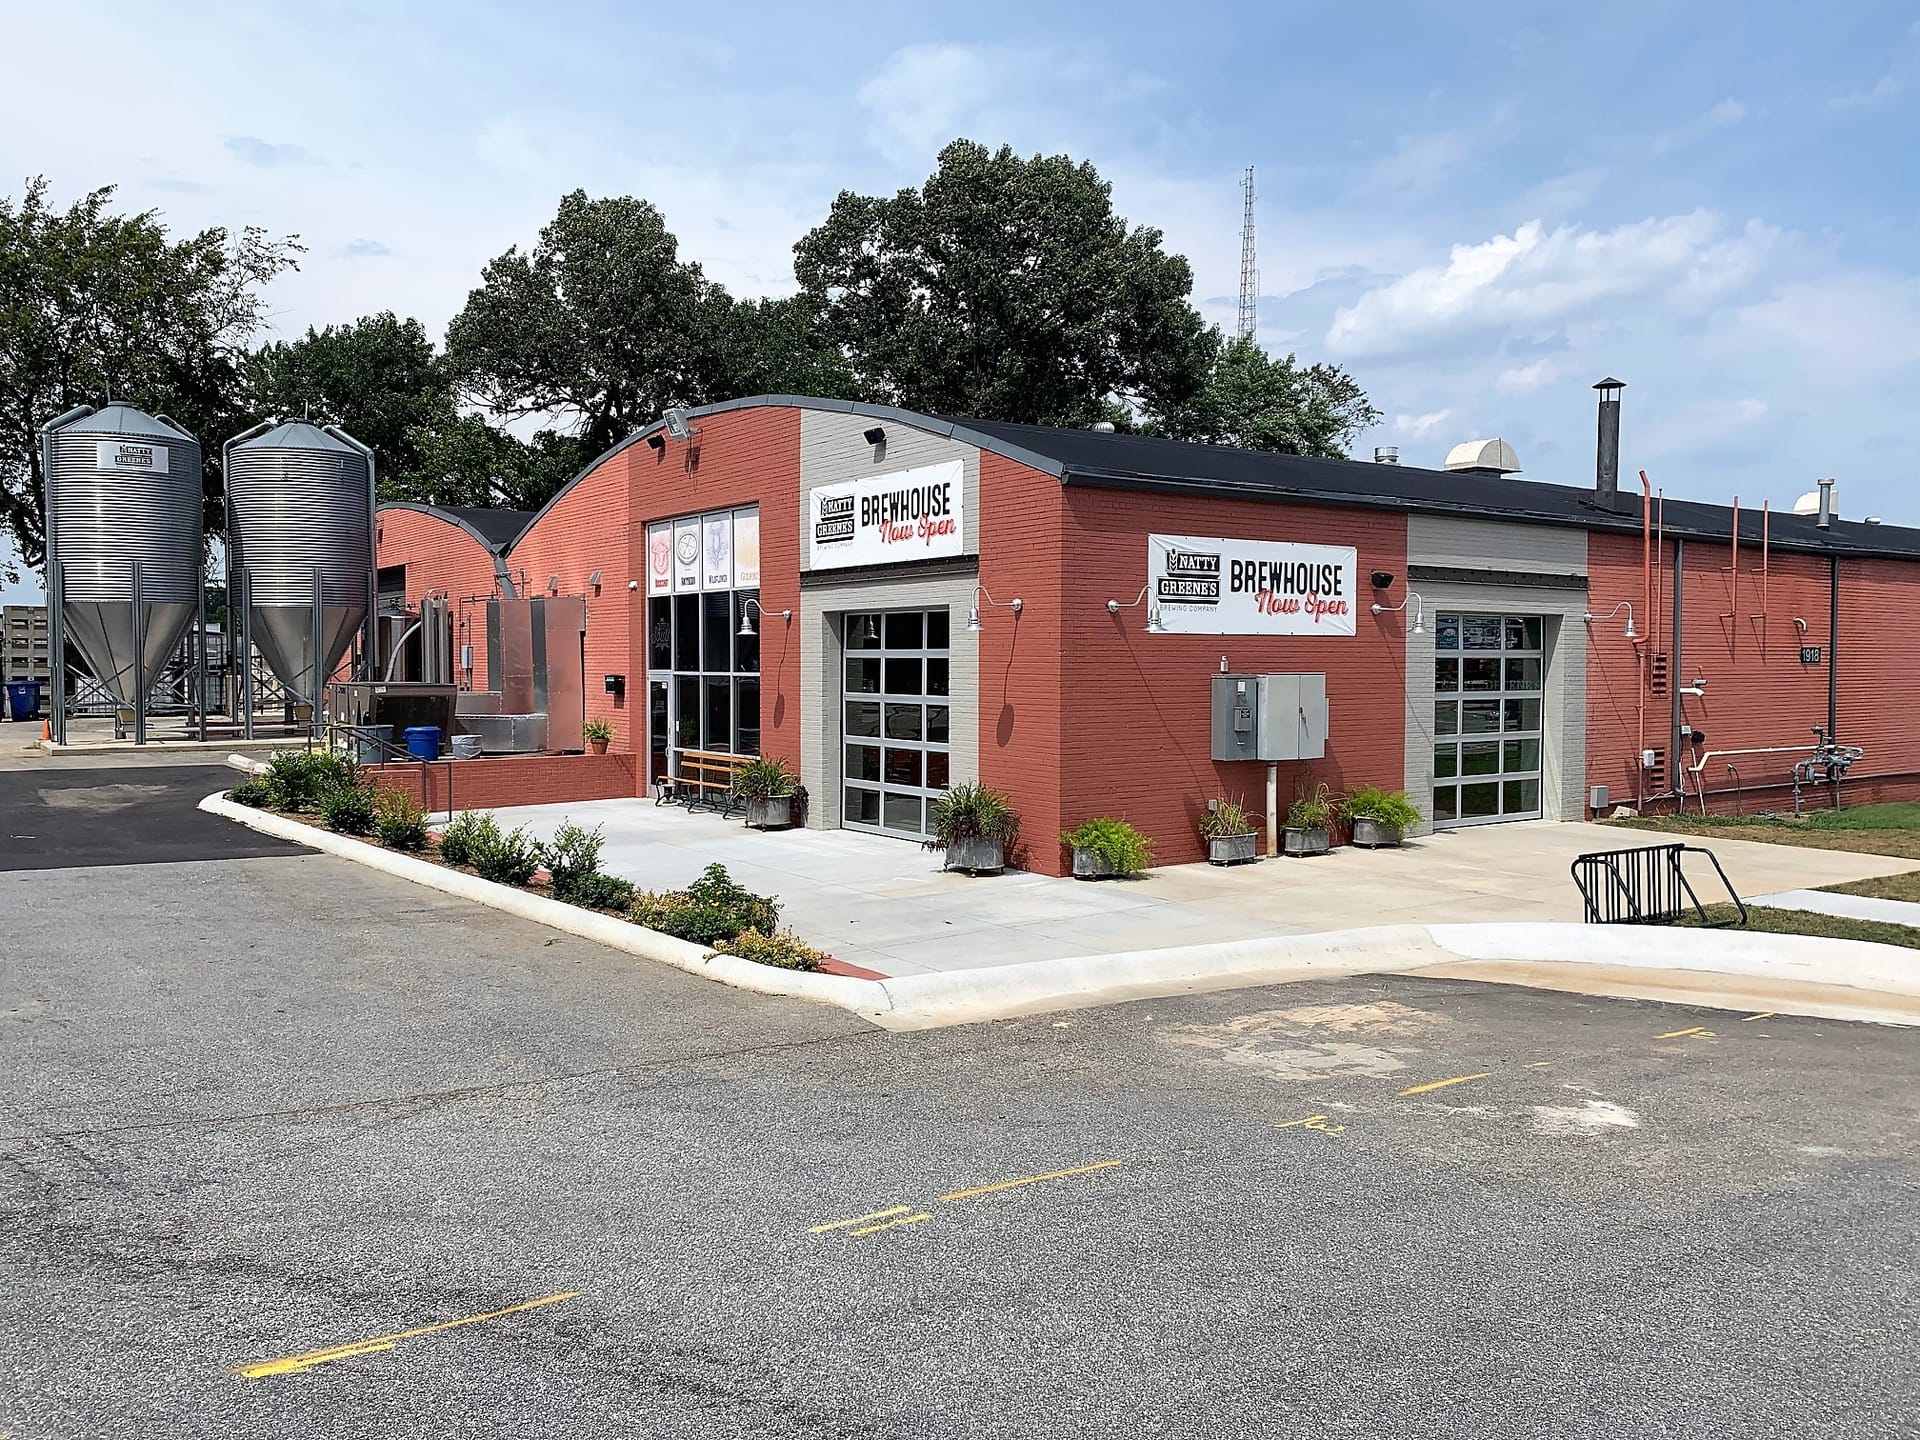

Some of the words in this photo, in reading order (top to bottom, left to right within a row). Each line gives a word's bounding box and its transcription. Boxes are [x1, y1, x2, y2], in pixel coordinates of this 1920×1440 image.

[828, 497, 853, 512] NATTY
[862, 482, 950, 527] BREWHOUSE
[879, 518, 914, 545] Now
[918, 513, 957, 547] Open
[1178, 555, 1217, 570] NATTY
[1231, 559, 1343, 596] BREWHOUSE
[1161, 580, 1217, 596] GREENE'S
[1160, 604, 1187, 612] BREWING
[1189, 604, 1217, 612] COMPANY
[1254, 589, 1300, 616] Now
[1304, 590, 1348, 623] Open
[1802, 649, 1819, 662] 1918
